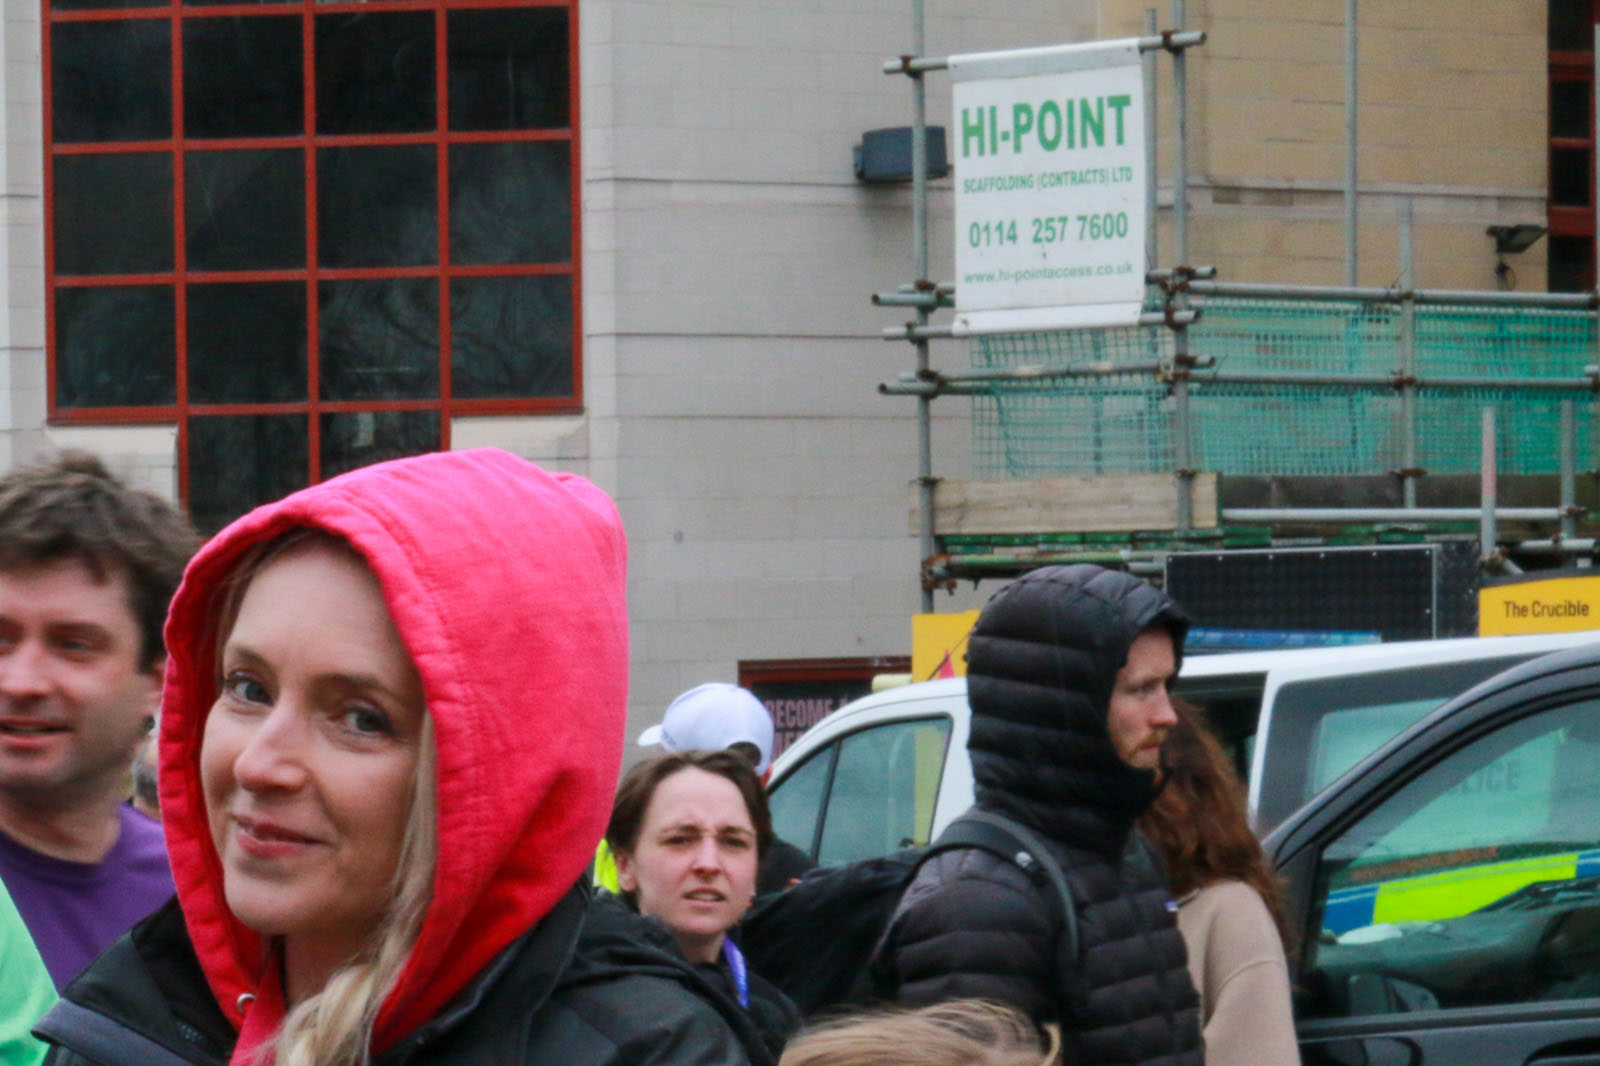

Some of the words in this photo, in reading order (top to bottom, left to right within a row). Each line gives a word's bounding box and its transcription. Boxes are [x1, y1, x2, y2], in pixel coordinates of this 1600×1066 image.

[961, 94, 1132, 158] HI-POINT
[963, 173, 1035, 194] SCAFFOLDING
[1037, 167, 1110, 191] (CONTRACTS)
[1112, 165, 1133, 183] LTD
[968, 219, 1018, 248] 0114
[1032, 215, 1069, 244] 257
[1076, 210, 1129, 241] 7600
[963, 262, 1134, 284] www.hi-pointaccess.co.uk
[1503, 600, 1528, 618] The
[1531, 599, 1590, 618] Crucible
